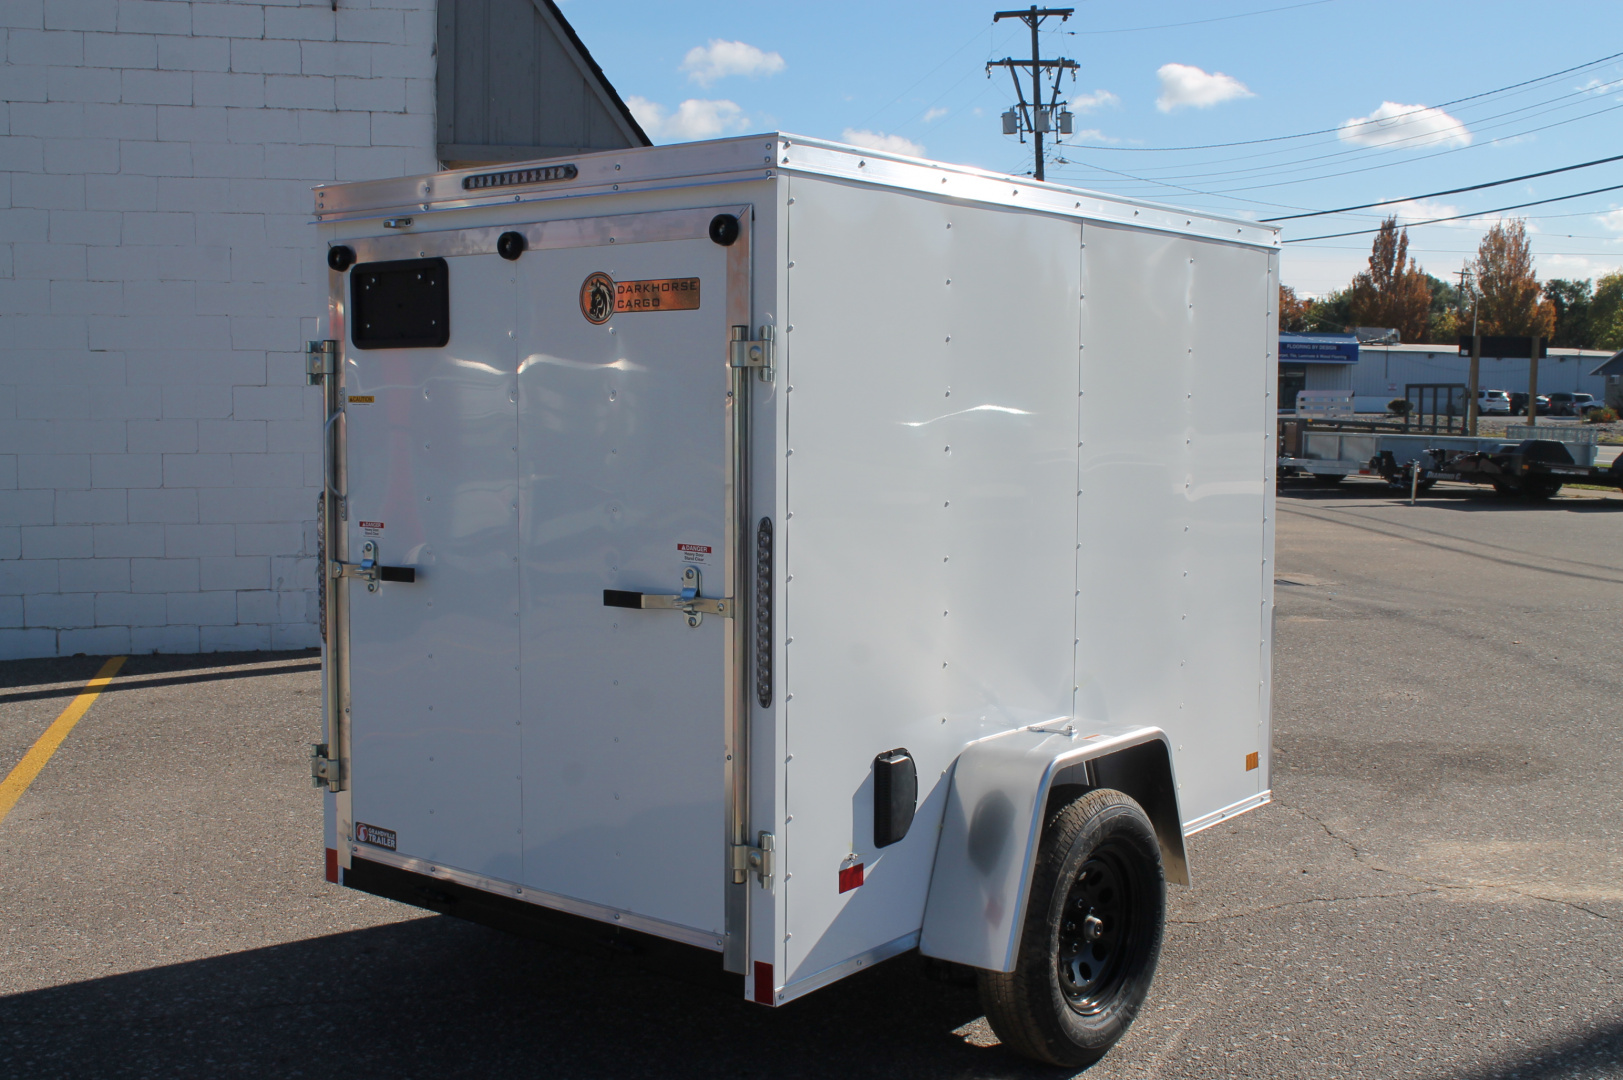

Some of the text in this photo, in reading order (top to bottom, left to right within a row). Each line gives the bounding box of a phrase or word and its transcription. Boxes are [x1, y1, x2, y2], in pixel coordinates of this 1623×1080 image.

[617, 281, 697, 294] DARKHORSE
[617, 298, 660, 309] CARGO
[368, 827, 395, 840] GRANDVILLE
[368, 833, 396, 848] TRAILER
